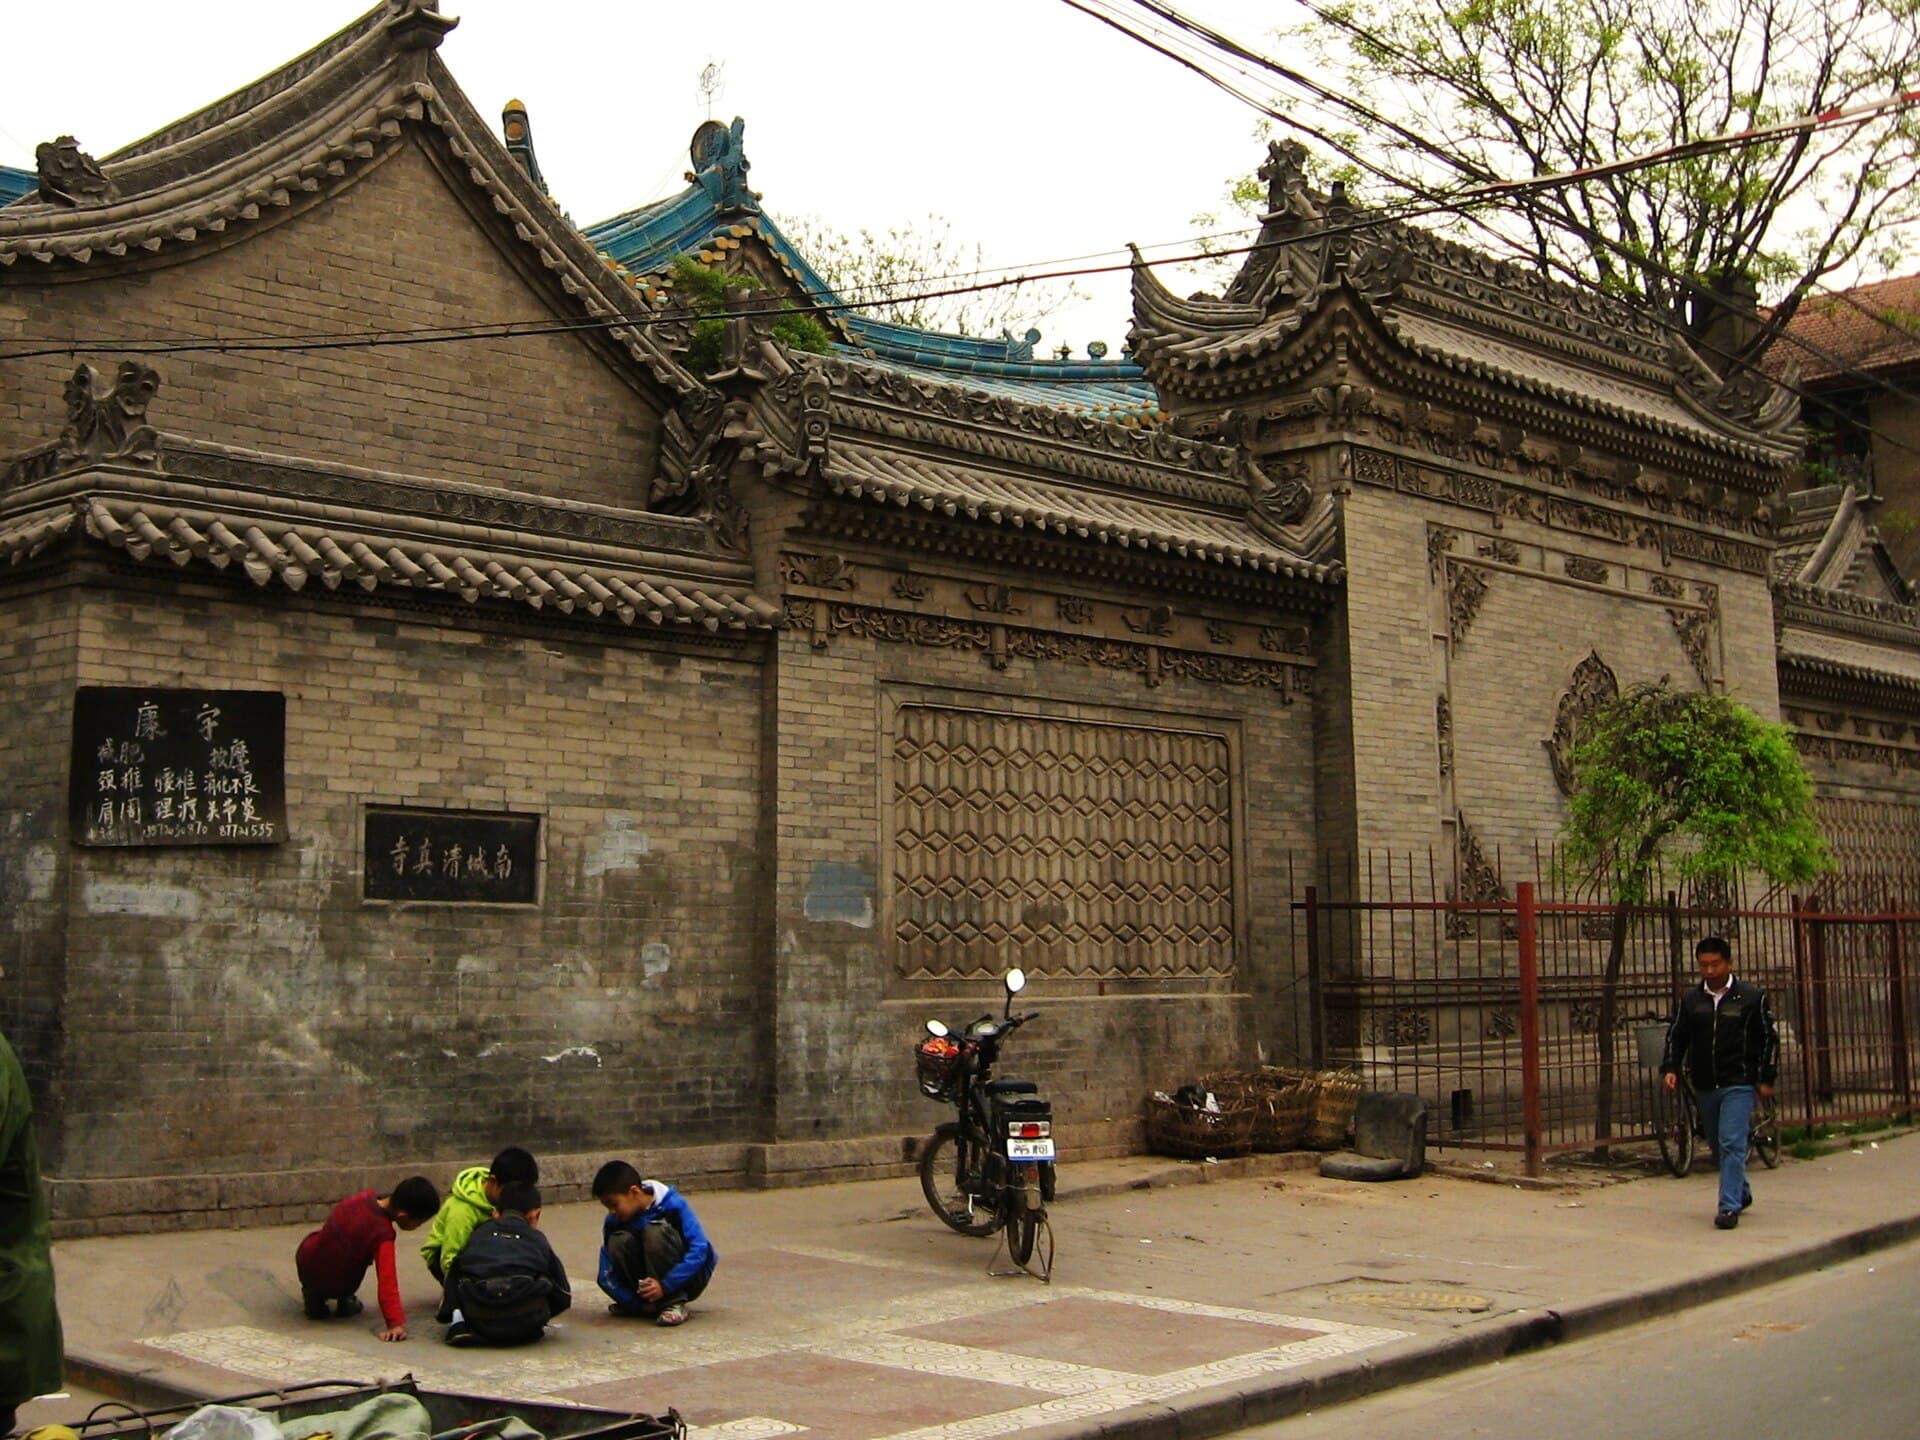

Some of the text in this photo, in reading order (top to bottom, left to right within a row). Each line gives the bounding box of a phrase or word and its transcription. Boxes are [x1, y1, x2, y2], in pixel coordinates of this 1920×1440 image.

[203, 771, 261, 795] 消化不良
[155, 796, 198, 822] 理疗
[206, 798, 261, 823] 关节炎
